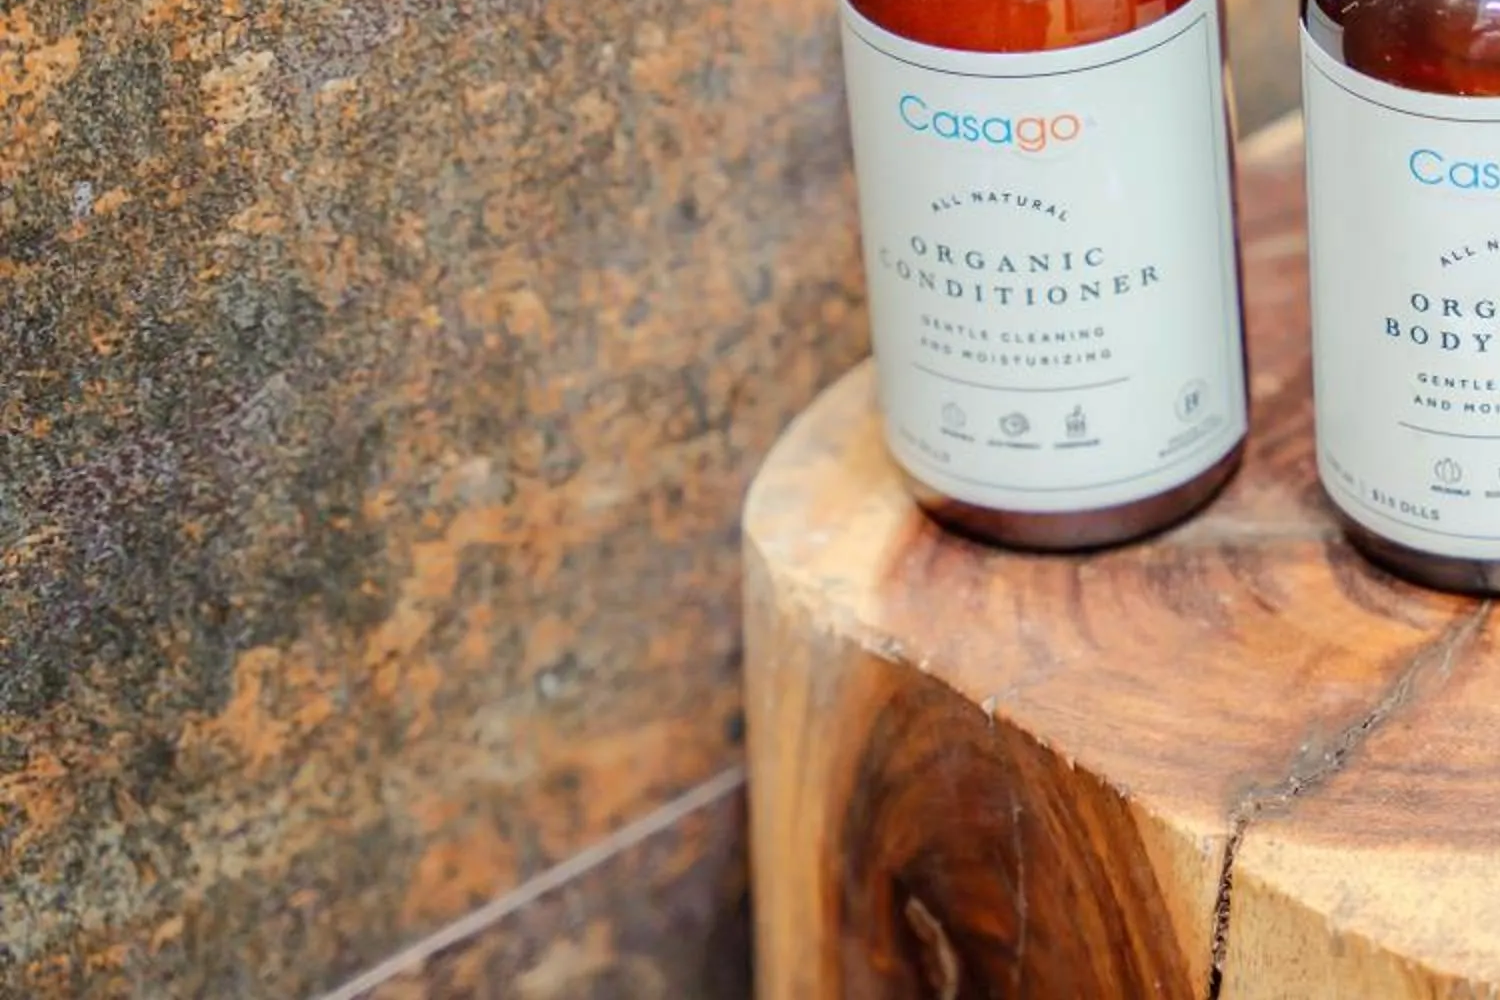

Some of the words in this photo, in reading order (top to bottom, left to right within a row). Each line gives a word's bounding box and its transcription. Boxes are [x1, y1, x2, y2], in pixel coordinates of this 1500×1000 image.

[900, 95, 1080, 152] Casago
[931, 193, 961, 213] ALL
[971, 191, 1067, 222] NATURAL
[910, 235, 1105, 273] ORGANIC
[1440, 246, 1476, 268] ALL
[879, 246, 1158, 305] CONDITIONER
[921, 314, 988, 341] GENTLE
[1001, 326, 1105, 344] CLEANING
[1385, 316, 1493, 353] BODY
[961, 348, 1112, 367] MOISTURIZING
[1417, 372, 1496, 391] GENTLE
[1414, 395, 1452, 411] AND
